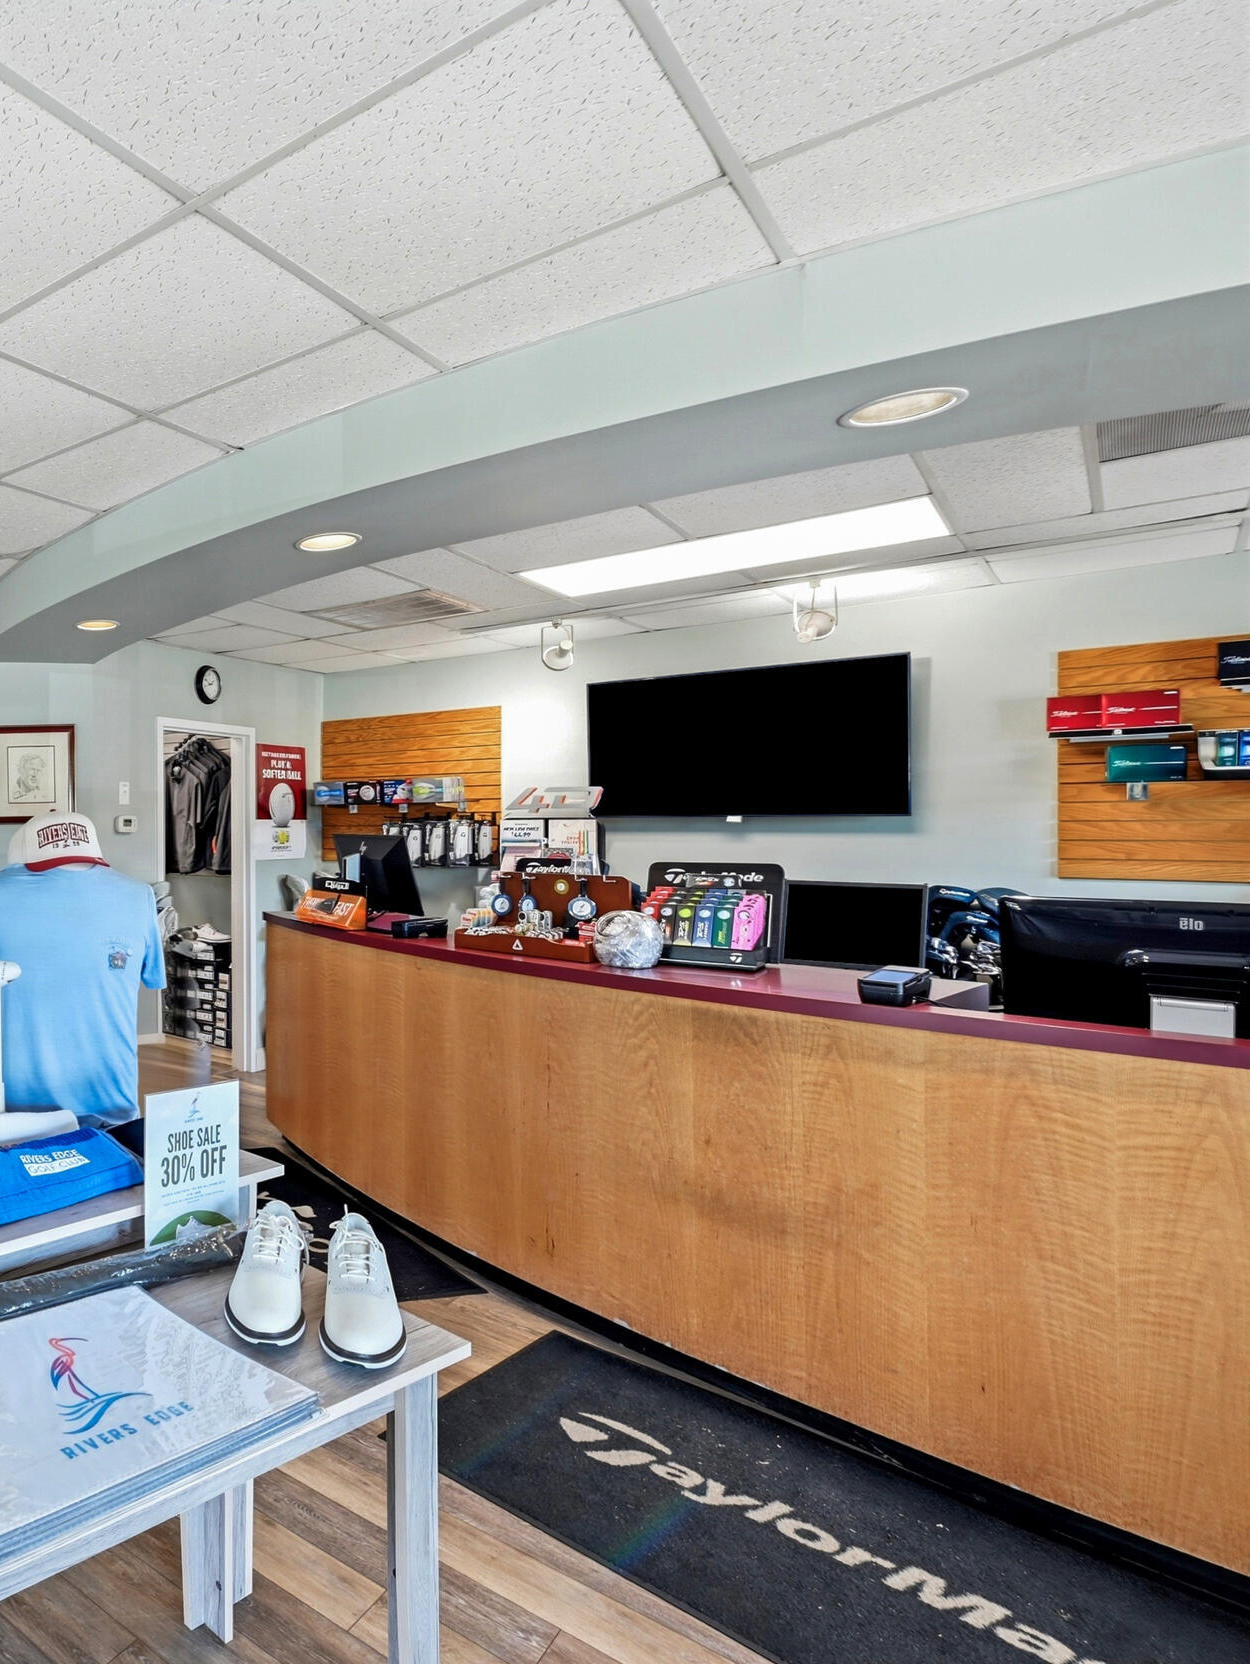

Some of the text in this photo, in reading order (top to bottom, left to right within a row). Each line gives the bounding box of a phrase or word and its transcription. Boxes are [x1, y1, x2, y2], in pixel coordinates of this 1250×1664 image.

[19, 1149, 80, 1164] RIVERS EDGE
[167, 1123, 222, 1153] SHOE SALE
[160, 1144, 228, 1188] 30% OFF
[59, 1401, 194, 1460] RIVERS EDGE
[559, 1411, 1106, 1664] TaylorMa
